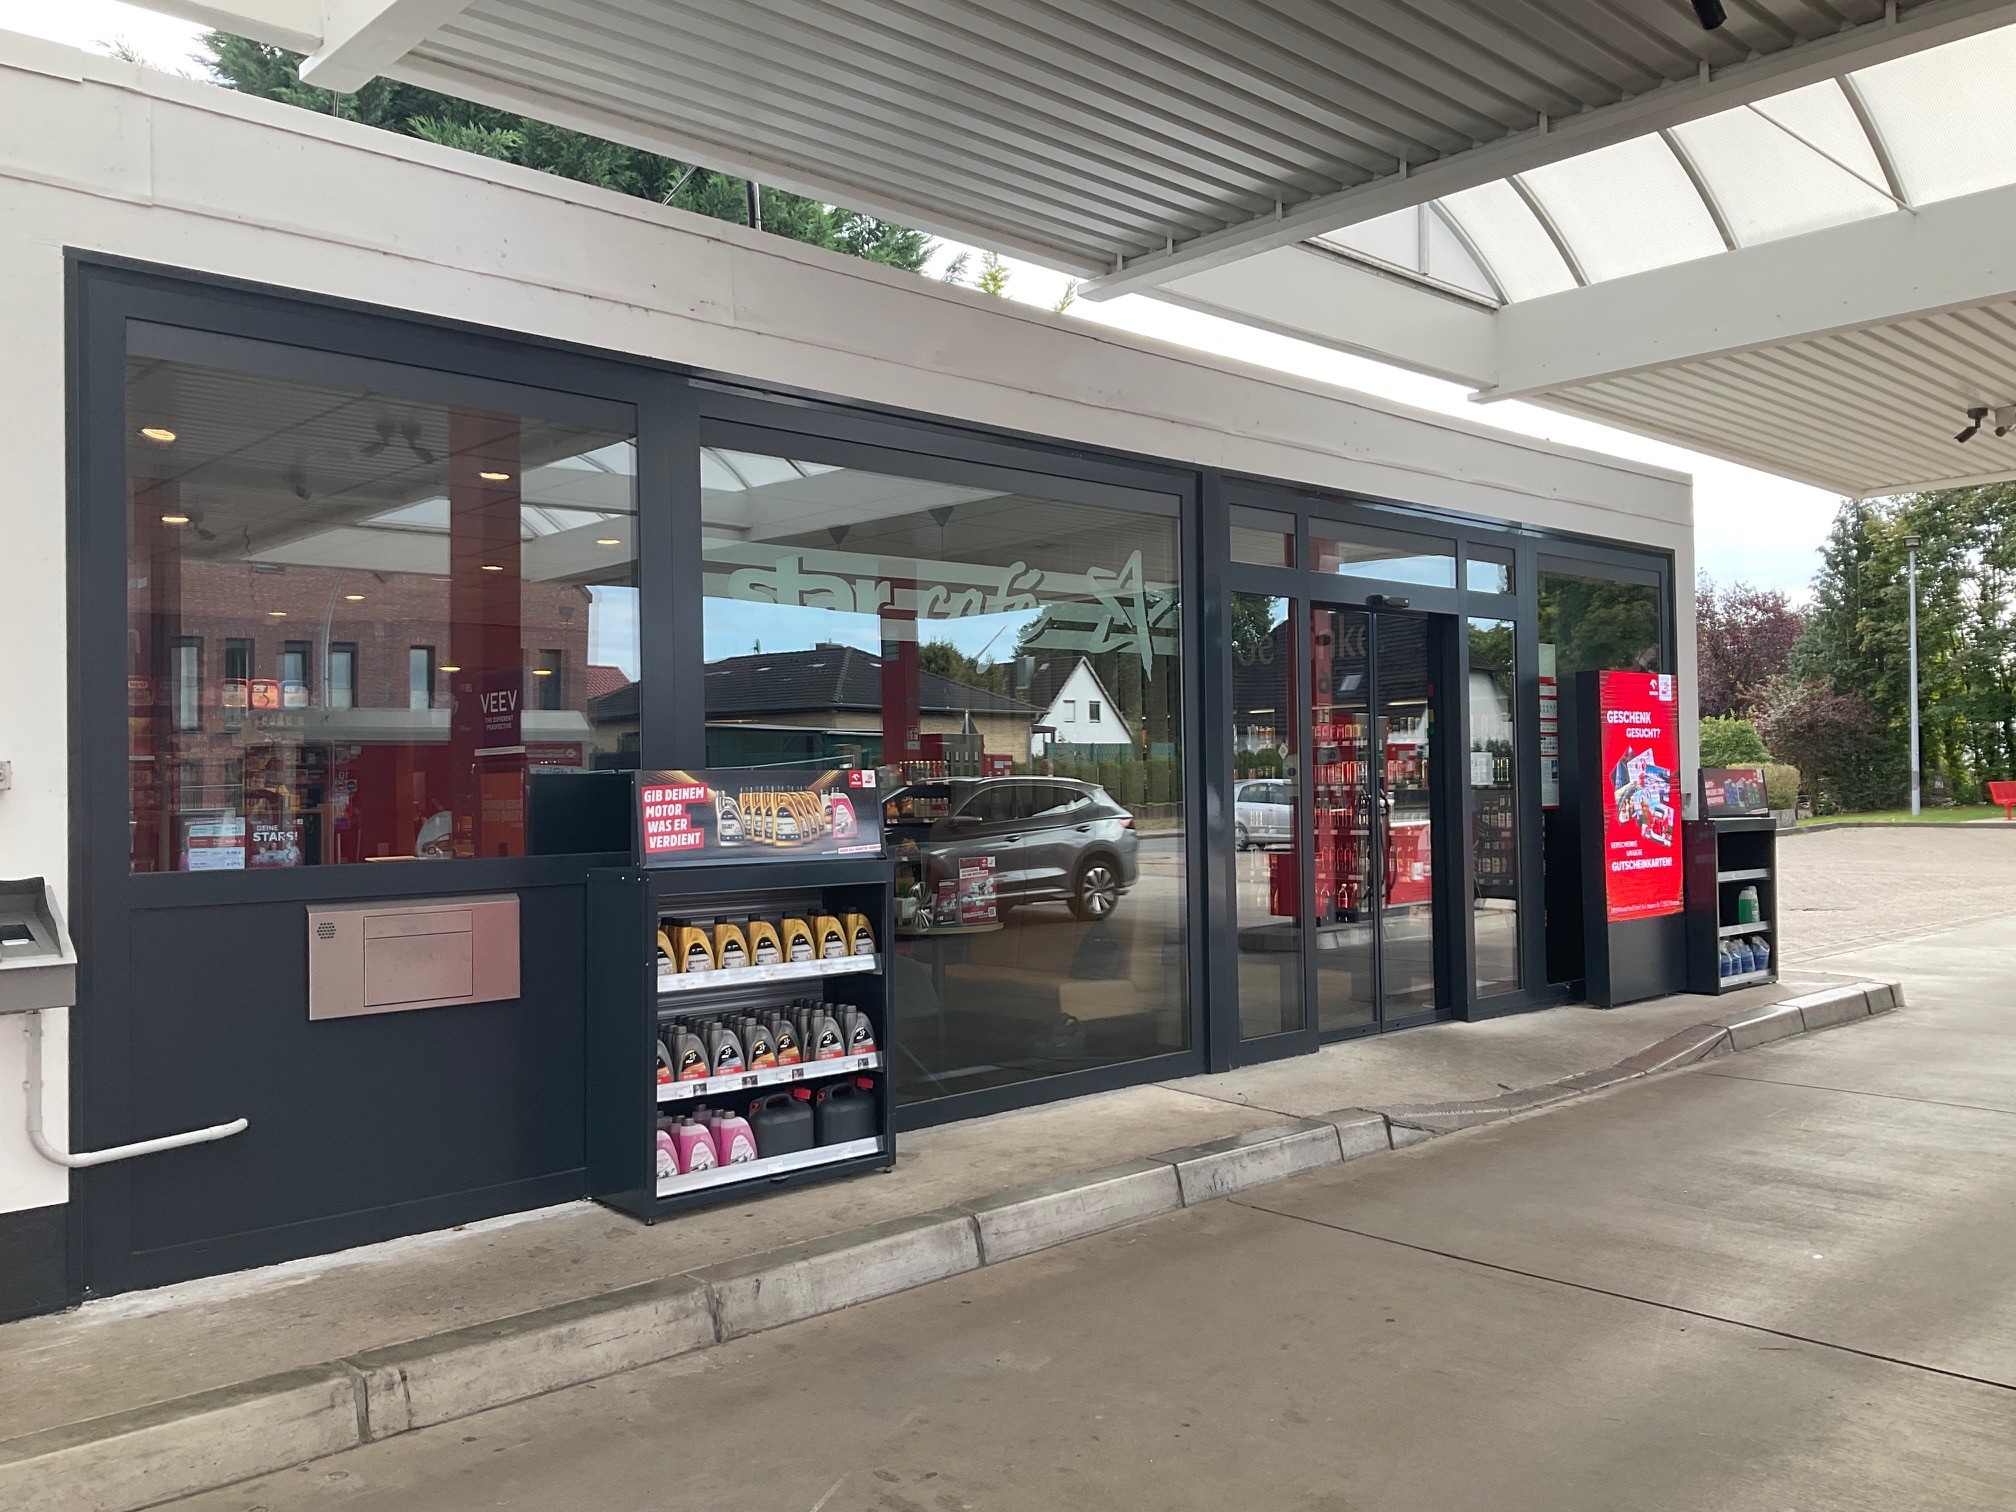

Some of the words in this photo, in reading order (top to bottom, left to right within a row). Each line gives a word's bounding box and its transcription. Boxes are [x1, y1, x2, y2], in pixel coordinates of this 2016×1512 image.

[480, 689, 518, 714] VEEV
[1607, 710, 1651, 724] GESCHENK
[1626, 728, 1661, 739] GESUCHT?
[643, 788, 663, 803] GIB
[665, 786, 705, 801] DEINEM
[645, 803, 682, 818] MOTOR
[648, 820, 672, 833] WAS
[673, 818, 687, 831] ER
[253, 831, 298, 842] STARS!
[649, 832, 701, 849] VERDIENT
